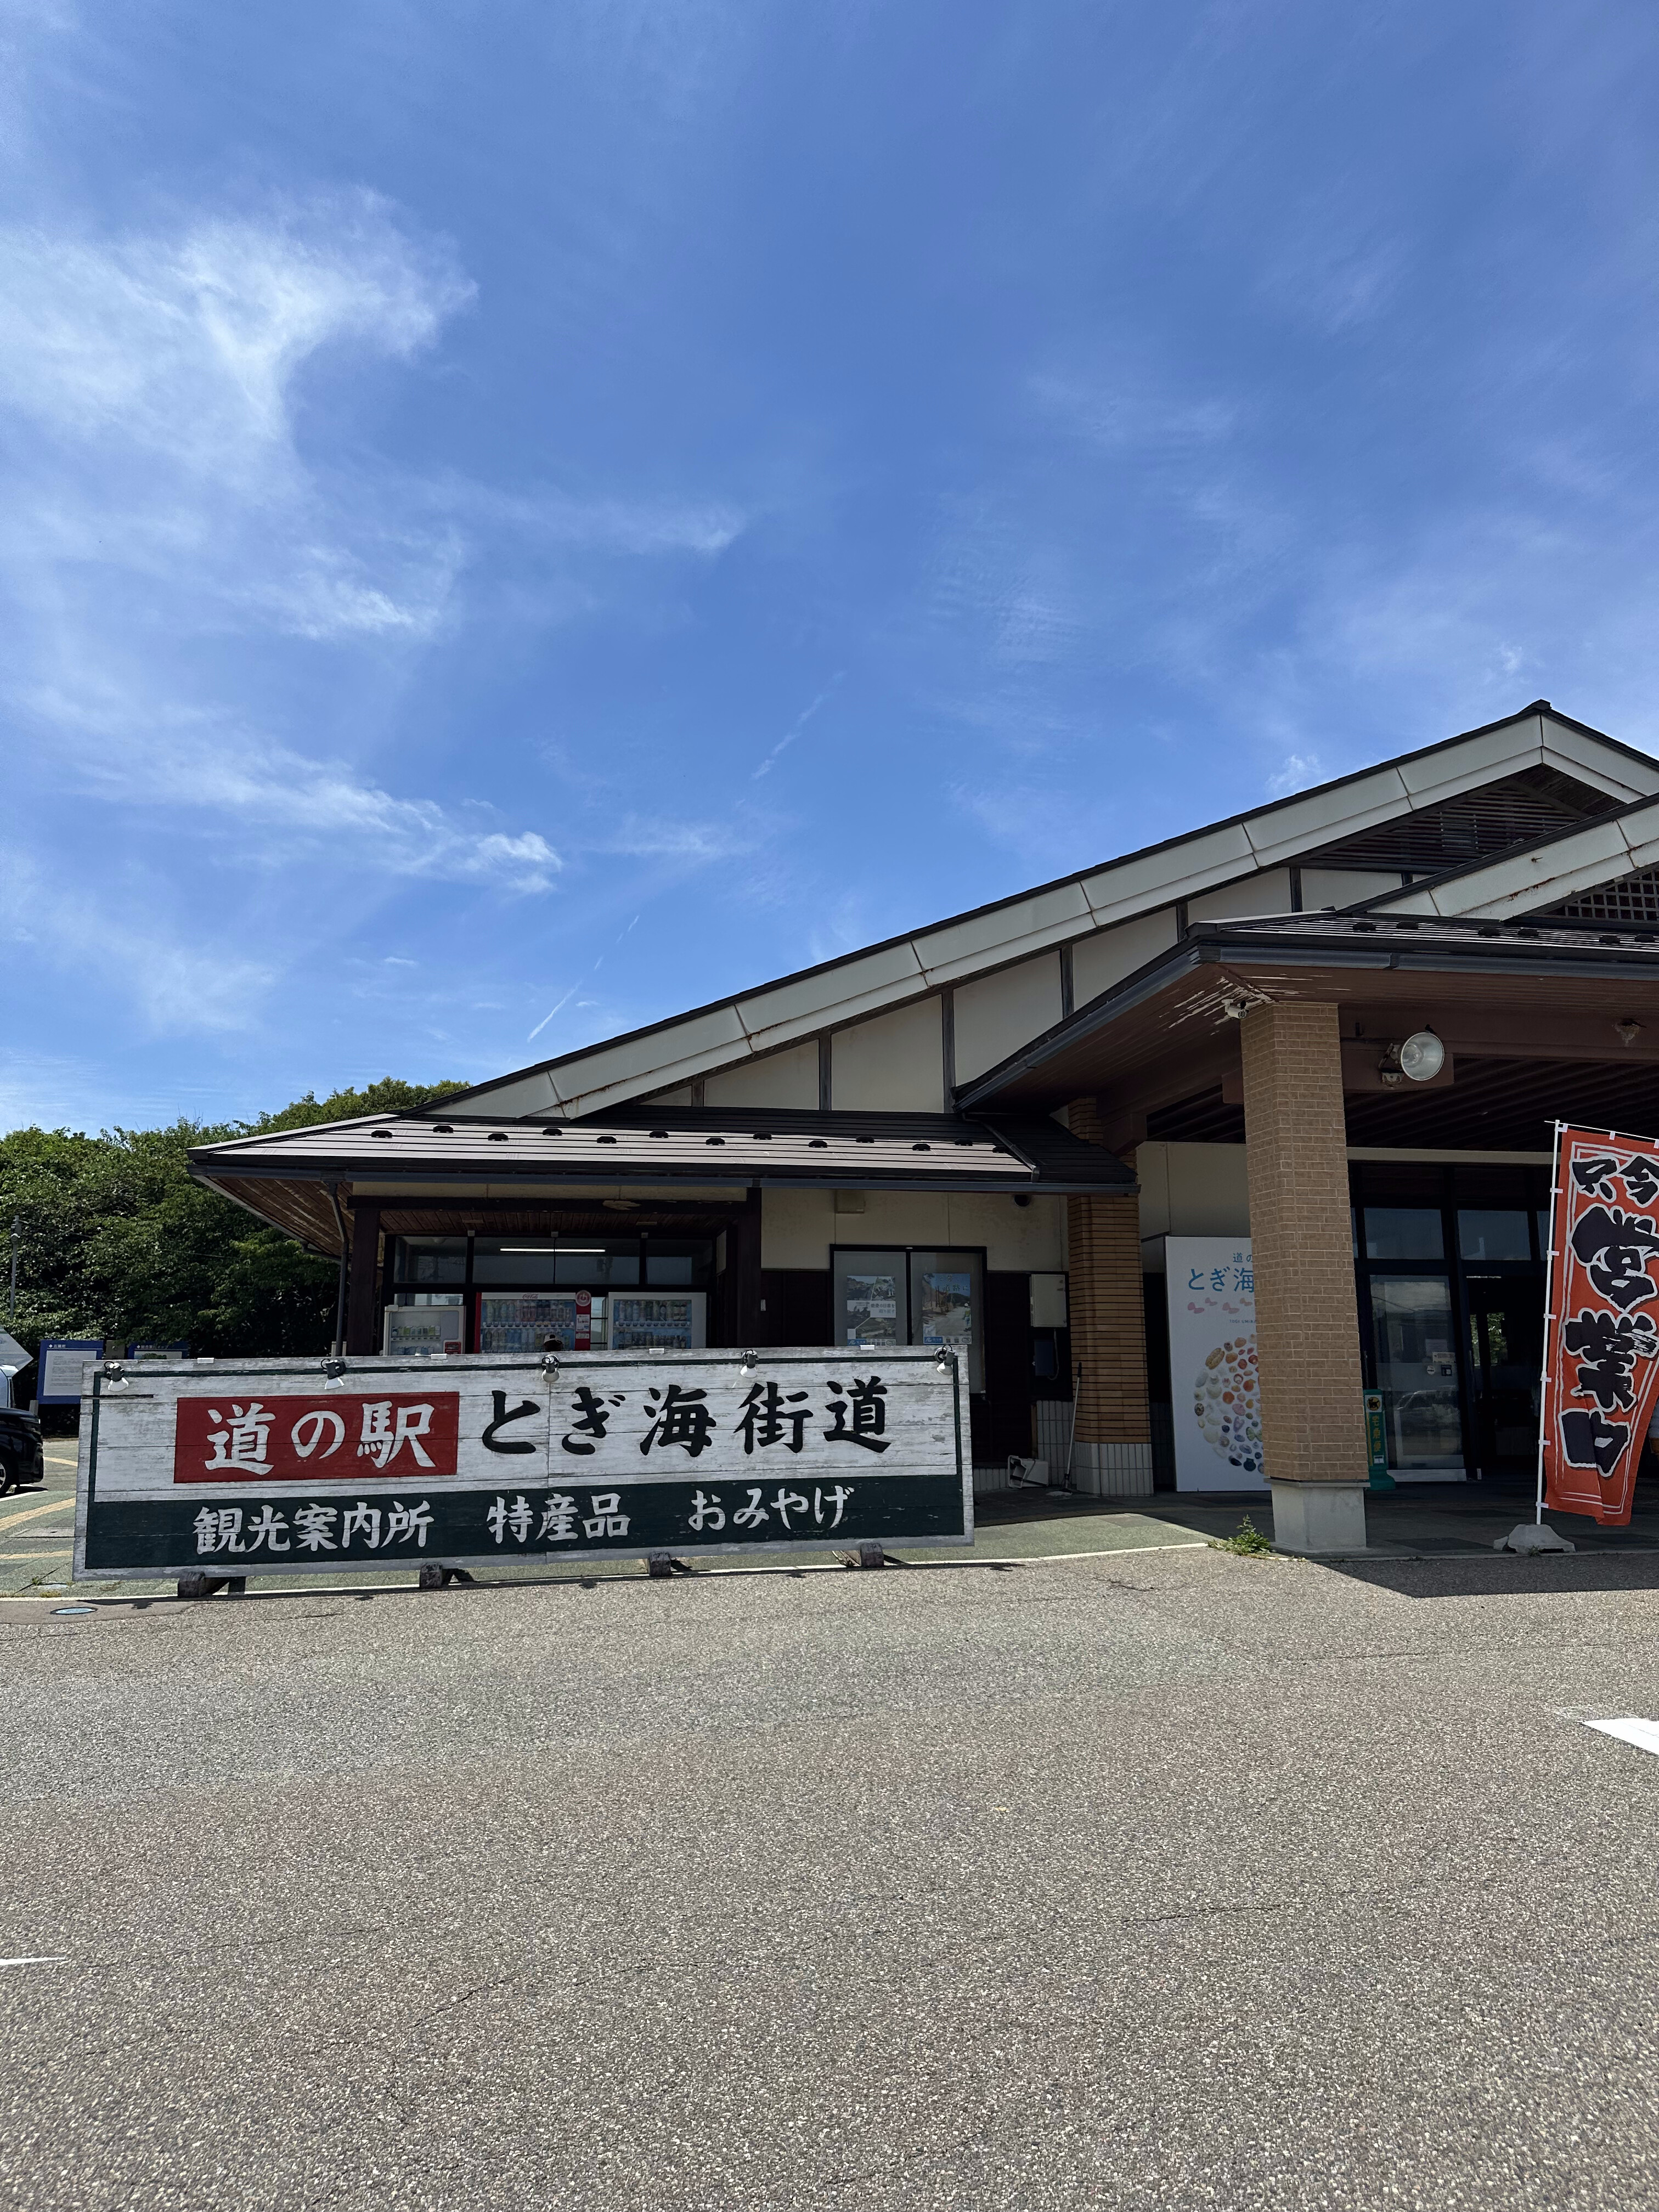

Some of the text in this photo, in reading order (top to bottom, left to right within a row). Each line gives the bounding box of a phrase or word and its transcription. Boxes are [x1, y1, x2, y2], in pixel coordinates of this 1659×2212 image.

[1188, 1266, 1255, 1293] とぎ海
[205, 1375, 892, 1476] 道の駅 とぎ海街道
[1372, 1415, 1381, 1452] 宅急便
[193, 1485, 854, 1555] 観光案内所 特産品 おみやげ
